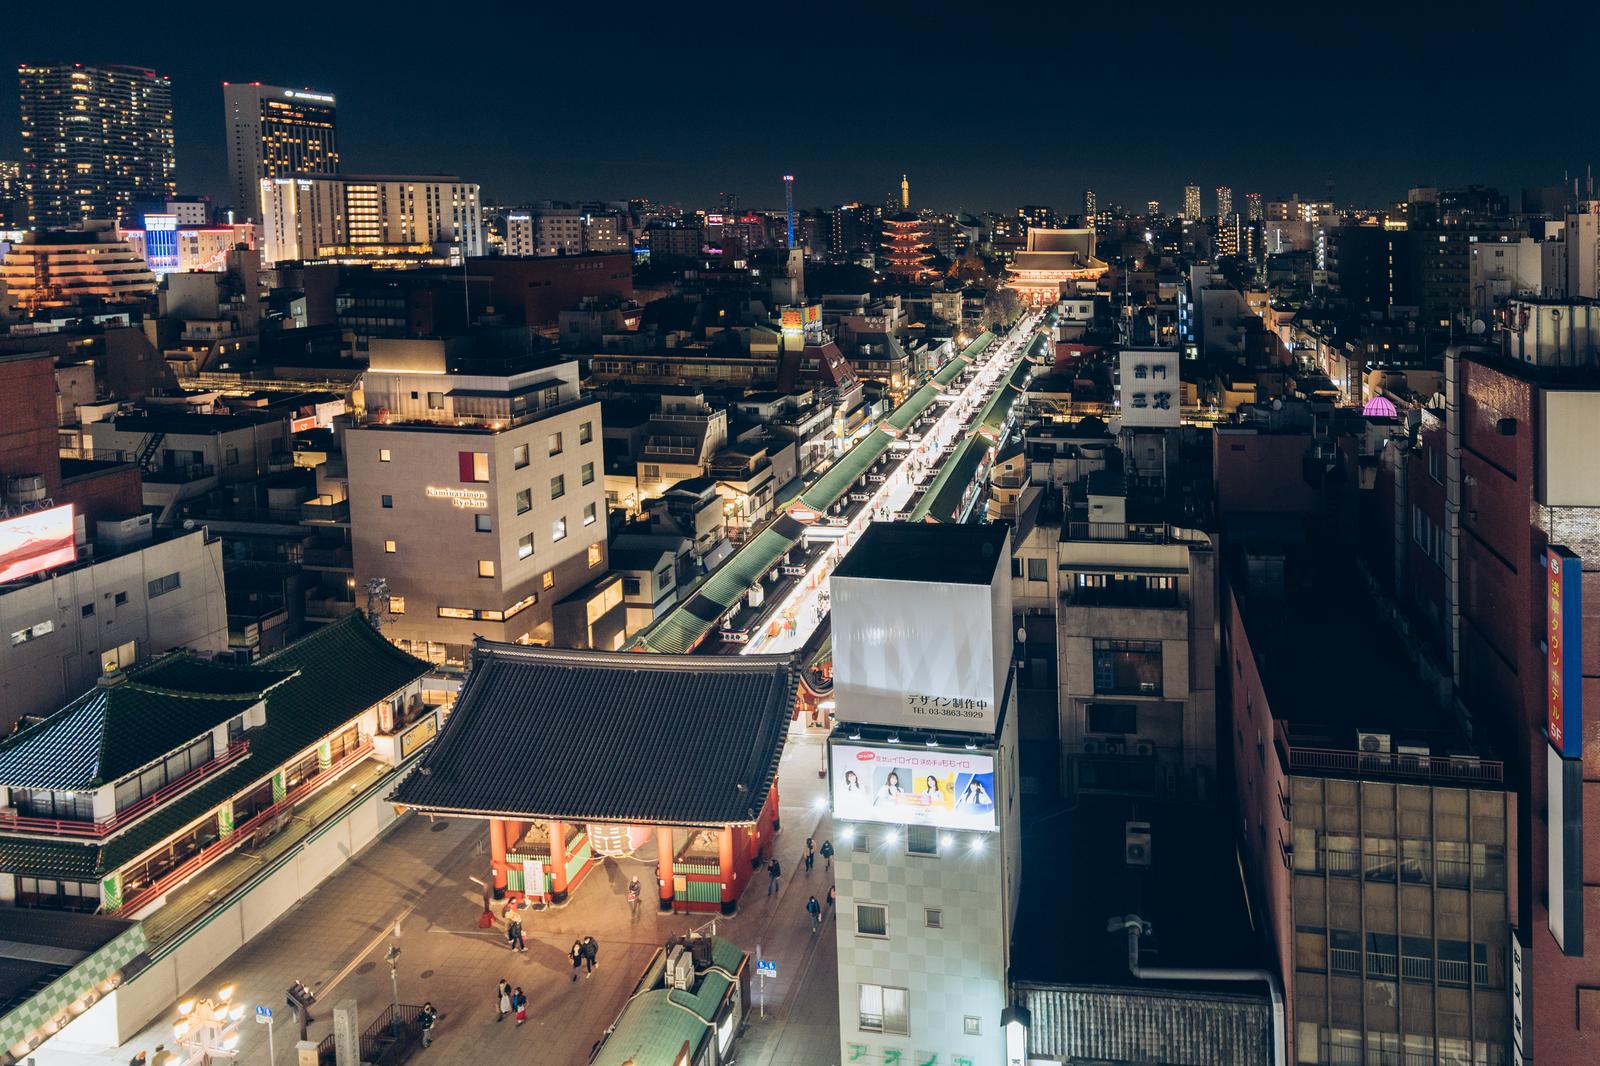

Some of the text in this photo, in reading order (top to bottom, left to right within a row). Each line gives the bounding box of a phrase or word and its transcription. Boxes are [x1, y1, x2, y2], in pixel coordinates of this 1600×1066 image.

[427, 487, 487, 499] Kaminarimon
[453, 498, 487, 508] Ryokan
[907, 694, 988, 710] デザイン制作中
[912, 706, 984, 719] TEL 03-3863-3929
[1551, 722, 1562, 741] 5F
